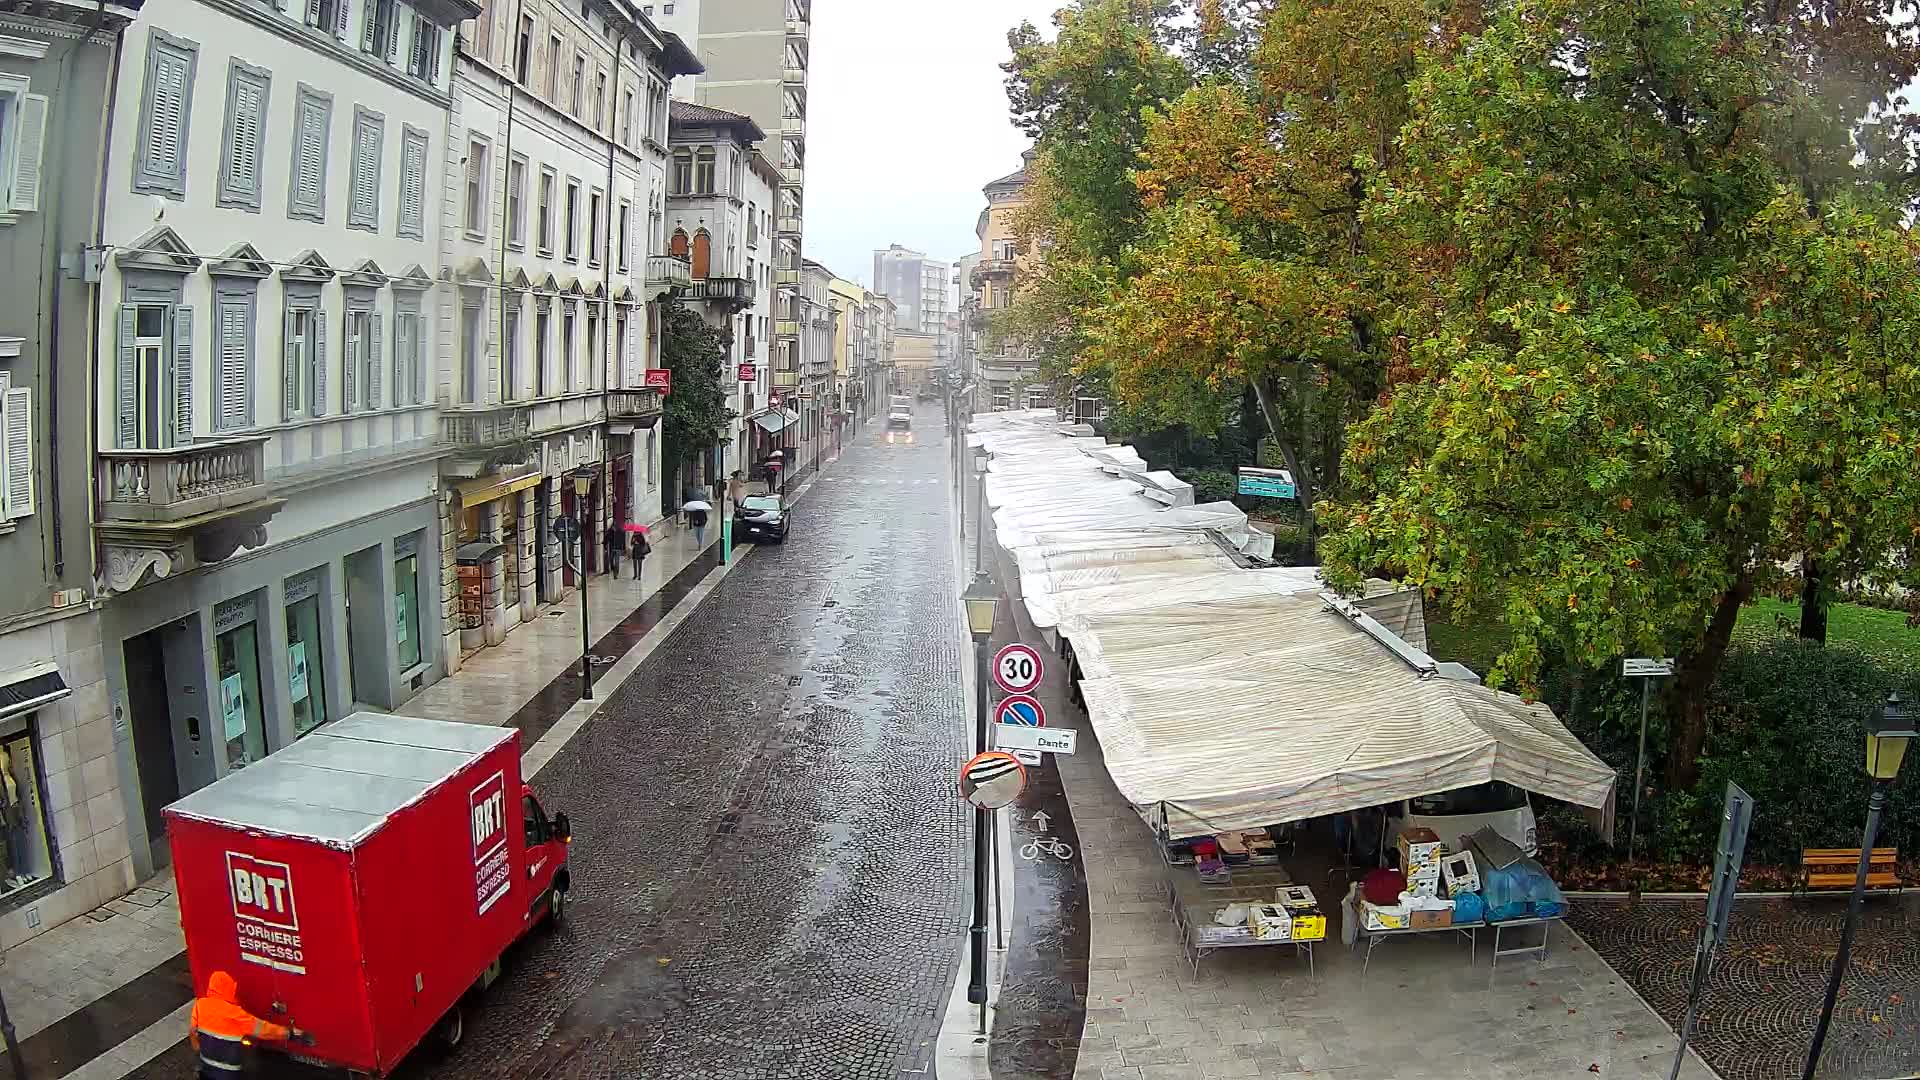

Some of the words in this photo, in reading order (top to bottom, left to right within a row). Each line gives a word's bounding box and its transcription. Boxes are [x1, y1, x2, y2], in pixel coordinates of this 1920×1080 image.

[1005, 658, 1033, 680] 30
[1038, 737, 1069, 749] Dante
[474, 790, 502, 846] BRT
[476, 847, 509, 884] CORRIERE
[234, 868, 286, 913] BRT
[477, 863, 510, 902] ESPRESSO
[236, 921, 302, 948] CORRIERE
[238, 936, 304, 962] ESPRESSO
